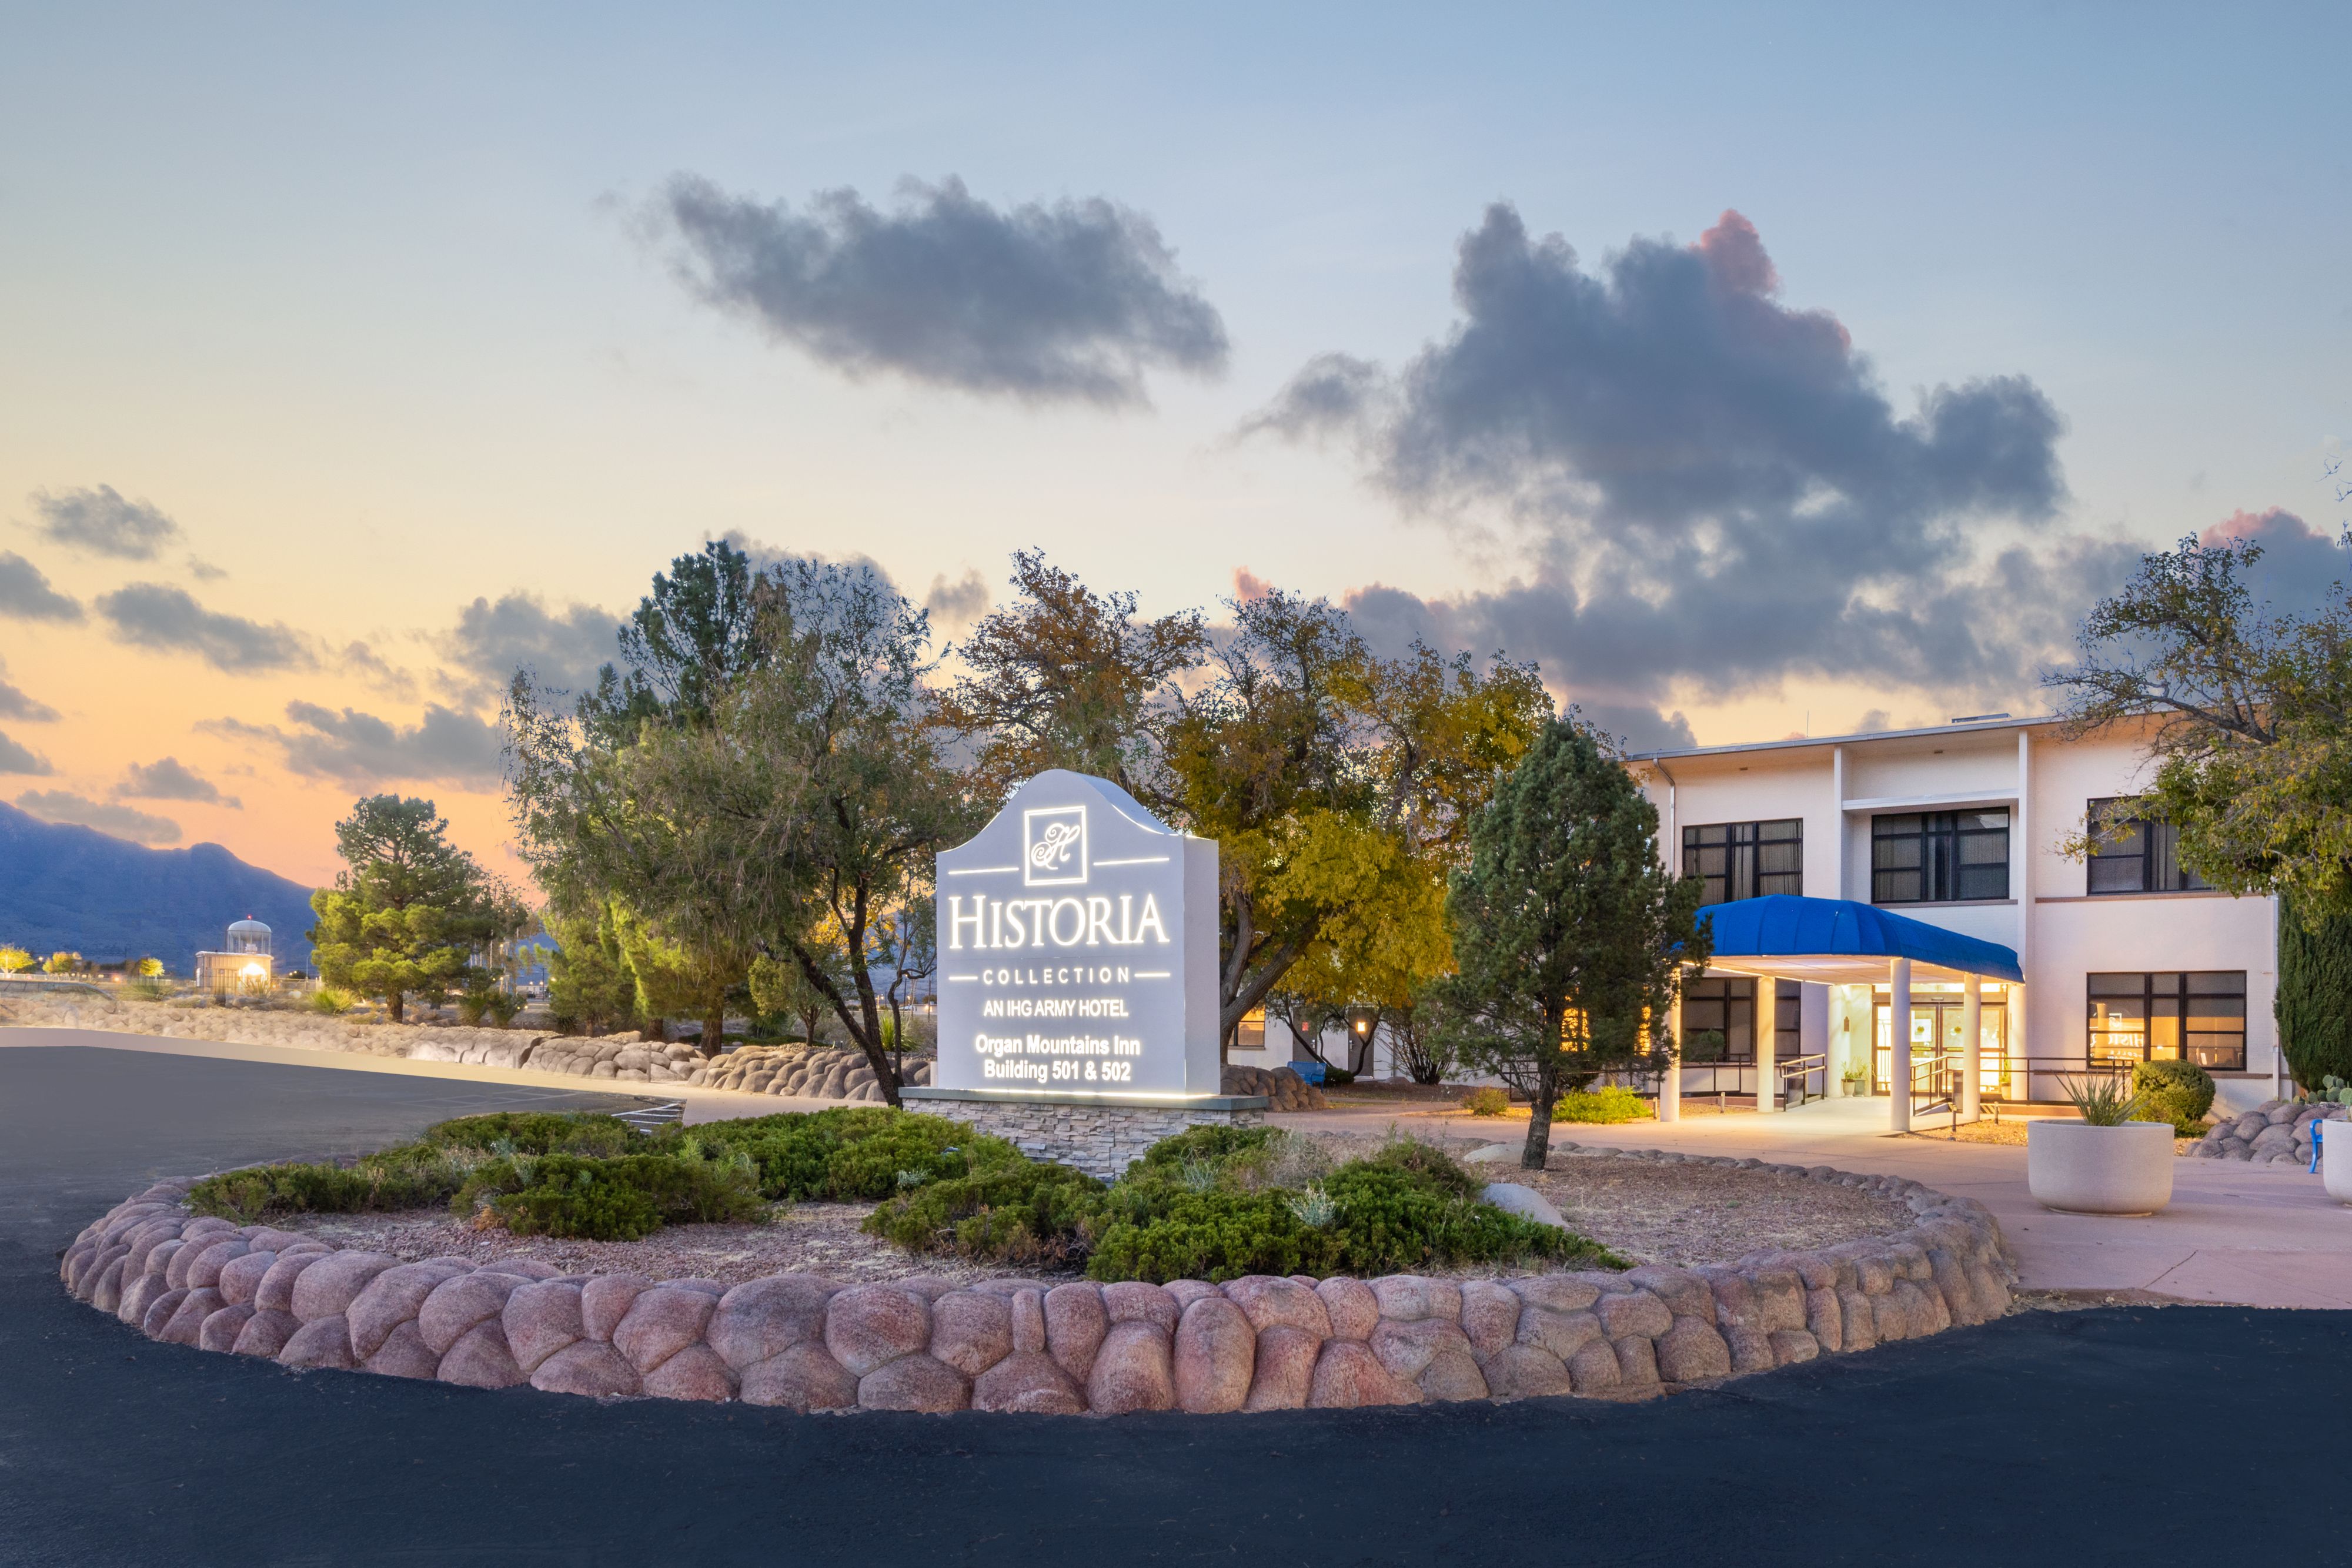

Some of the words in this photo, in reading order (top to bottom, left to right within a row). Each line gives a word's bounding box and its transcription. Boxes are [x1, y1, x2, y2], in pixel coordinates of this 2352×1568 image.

[948, 894, 1170, 949] HISTORIA
[983, 967, 1130, 984] COLLECTION
[984, 1000, 1003, 1017] AN
[1007, 1000, 1032, 1017] IHG
[1034, 999, 1076, 1017] ARMY
[1079, 999, 1129, 1017] HOTEL
[975, 1034, 1022, 1057] Organ
[1027, 1035, 1110, 1054] Mountains
[1114, 1035, 1140, 1055] Inn
[984, 1059, 1048, 1084] Building
[1052, 1061, 1078, 1079] 501
[1084, 1061, 1097, 1080] &
[1101, 1061, 1131, 1081] 502
